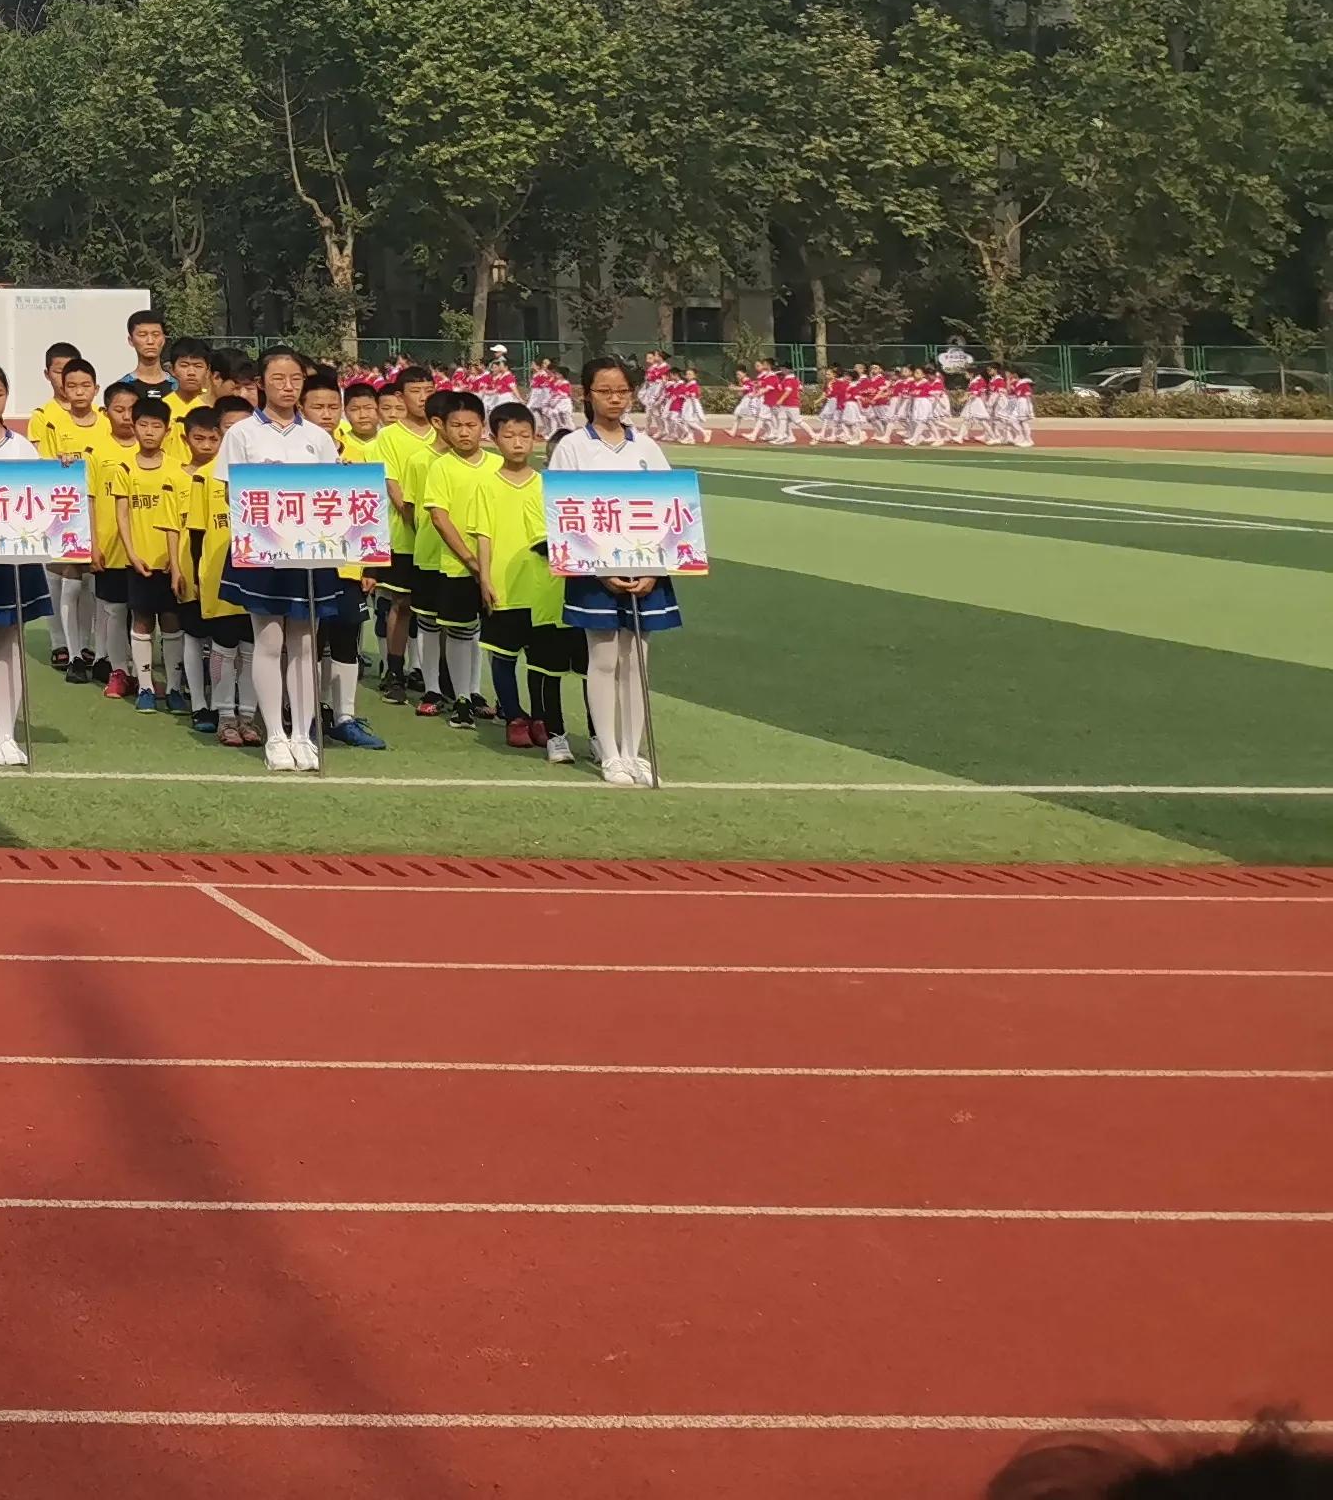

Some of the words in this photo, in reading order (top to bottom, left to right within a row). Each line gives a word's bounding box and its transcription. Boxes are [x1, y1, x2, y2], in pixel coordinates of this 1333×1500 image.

[240, 489, 380, 527] 渭河学校
[556, 497, 694, 534] 高新三小
